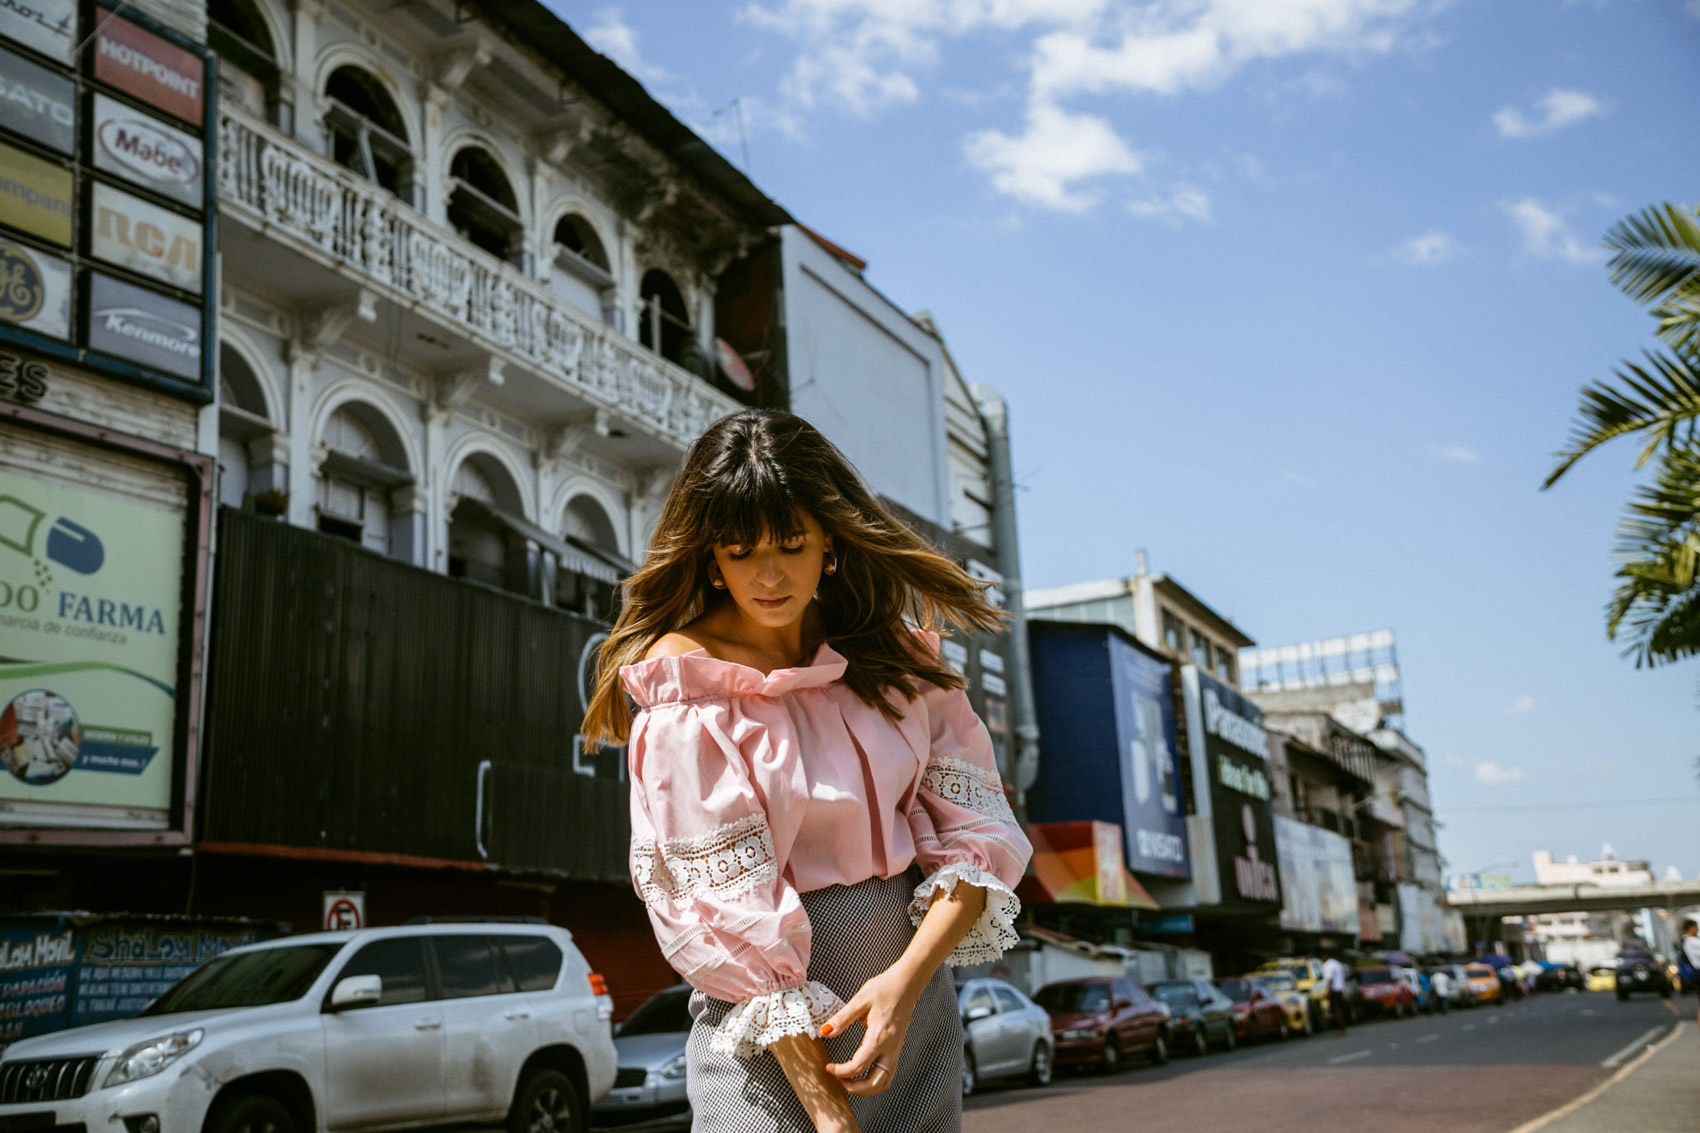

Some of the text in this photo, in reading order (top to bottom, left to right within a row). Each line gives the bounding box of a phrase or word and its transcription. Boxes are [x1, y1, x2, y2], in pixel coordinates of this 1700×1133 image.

[100, 36, 200, 99] HOTPOINT
[0, 76, 73, 127] ATO
[114, 128, 181, 174] Mabe
[98, 206, 197, 271] RCA
[44, 619, 61, 634] de
[58, 590, 166, 635] FARMA
